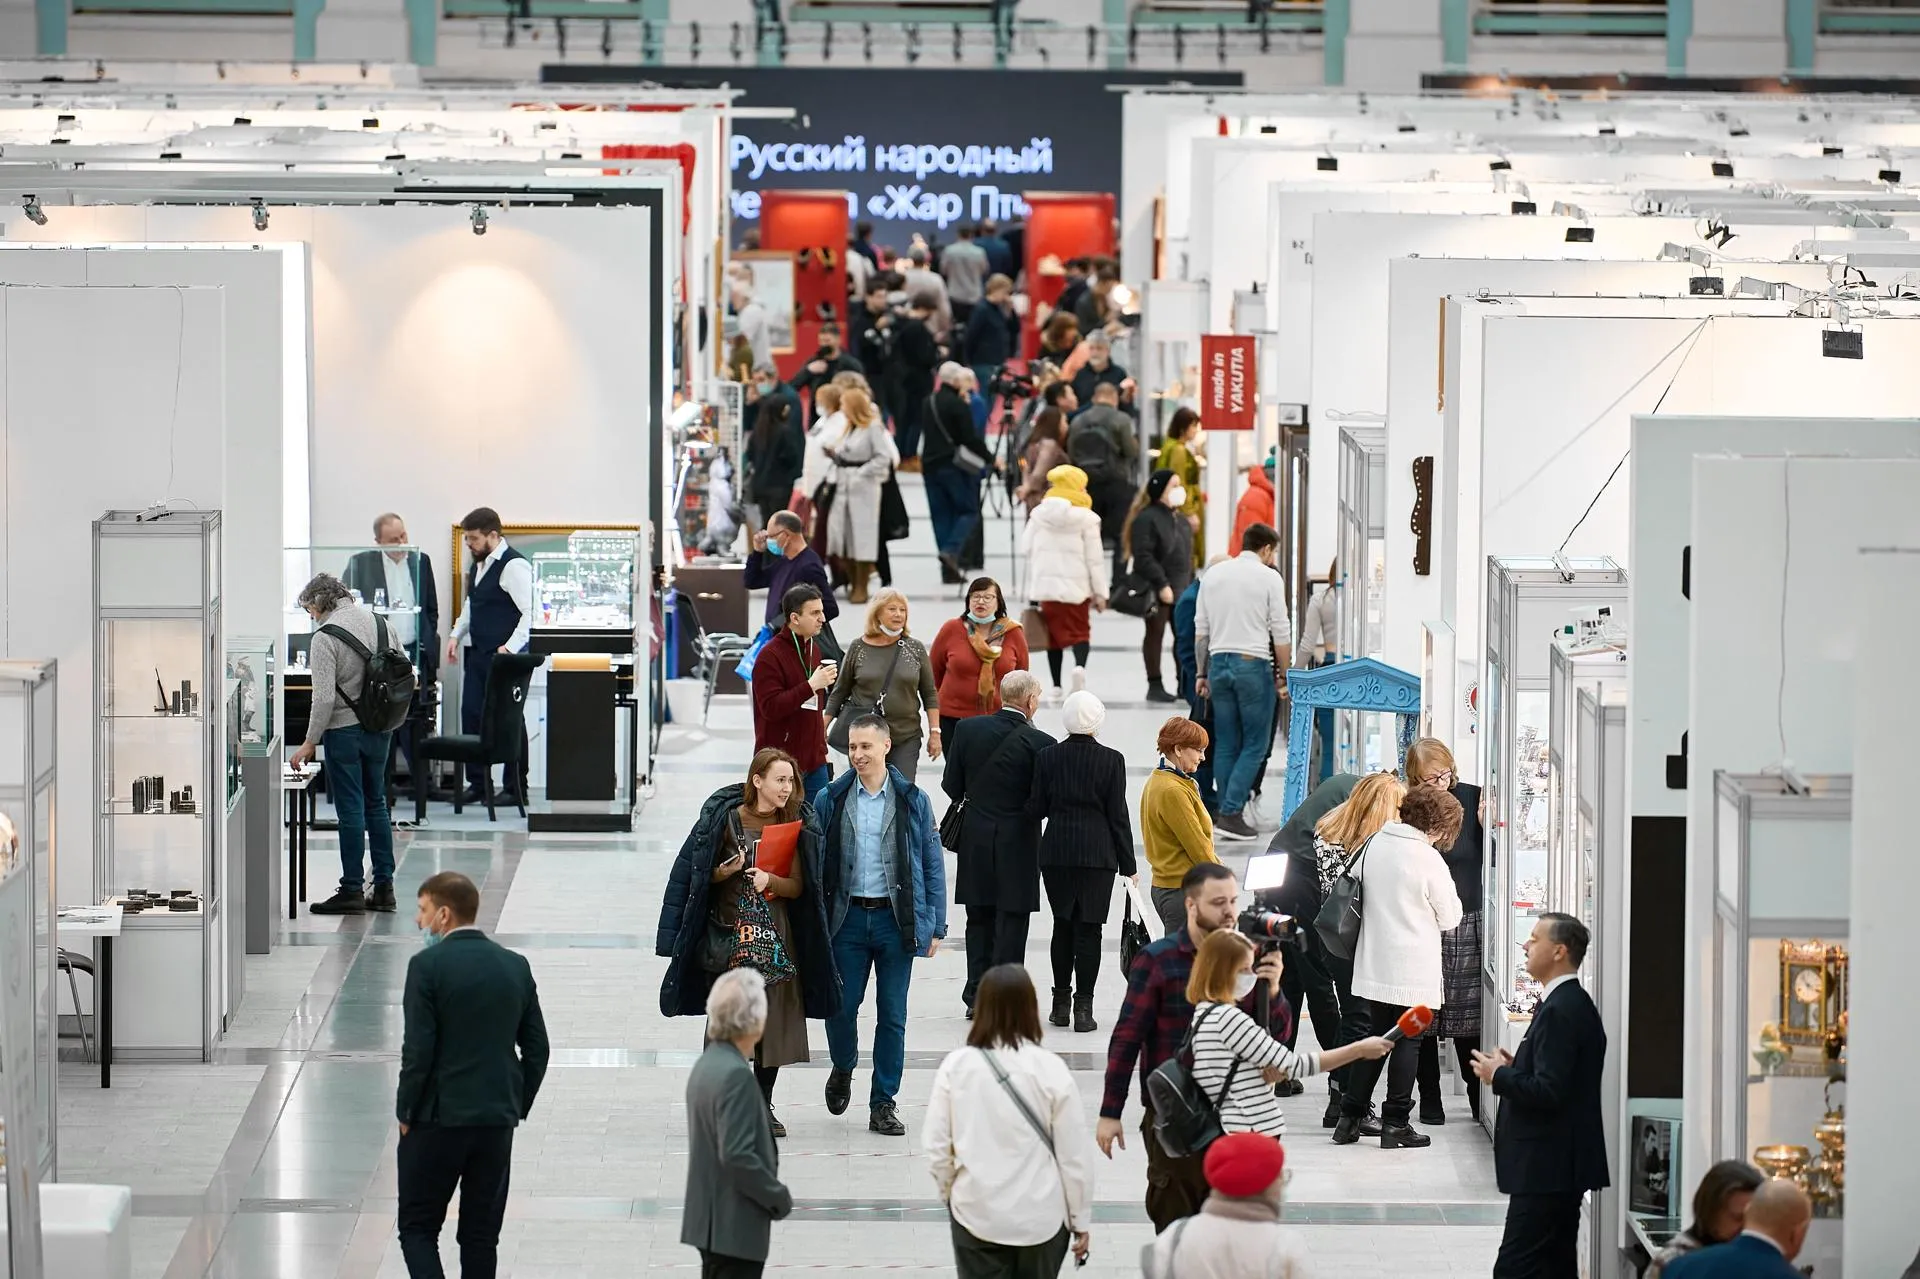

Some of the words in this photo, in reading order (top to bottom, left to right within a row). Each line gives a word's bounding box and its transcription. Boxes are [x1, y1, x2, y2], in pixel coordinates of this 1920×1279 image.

[731, 134, 866, 180] Русский
[874, 136, 1053, 181] народный
[867, 184, 963, 230] «Жар
[1212, 352, 1225, 367] in
[1230, 347, 1244, 413] YAKUTIA
[1212, 368, 1225, 409] made
